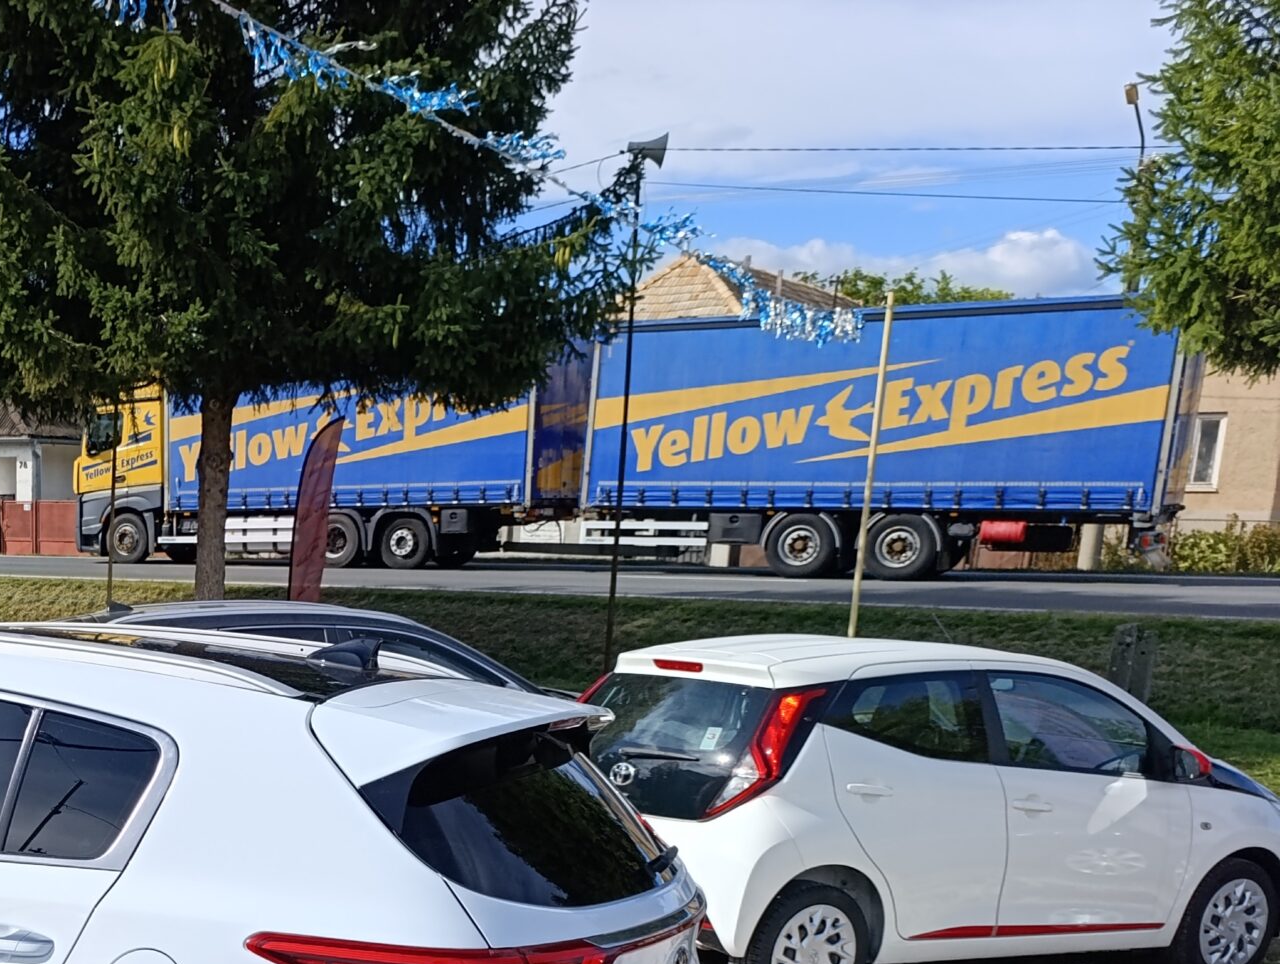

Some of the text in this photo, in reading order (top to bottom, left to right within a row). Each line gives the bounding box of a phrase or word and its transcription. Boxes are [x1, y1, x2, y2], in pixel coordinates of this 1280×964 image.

[631, 345, 1131, 473] Yellow Express
[85, 450, 154, 481] Yellow Express
[178, 422, 308, 483] Ylow
